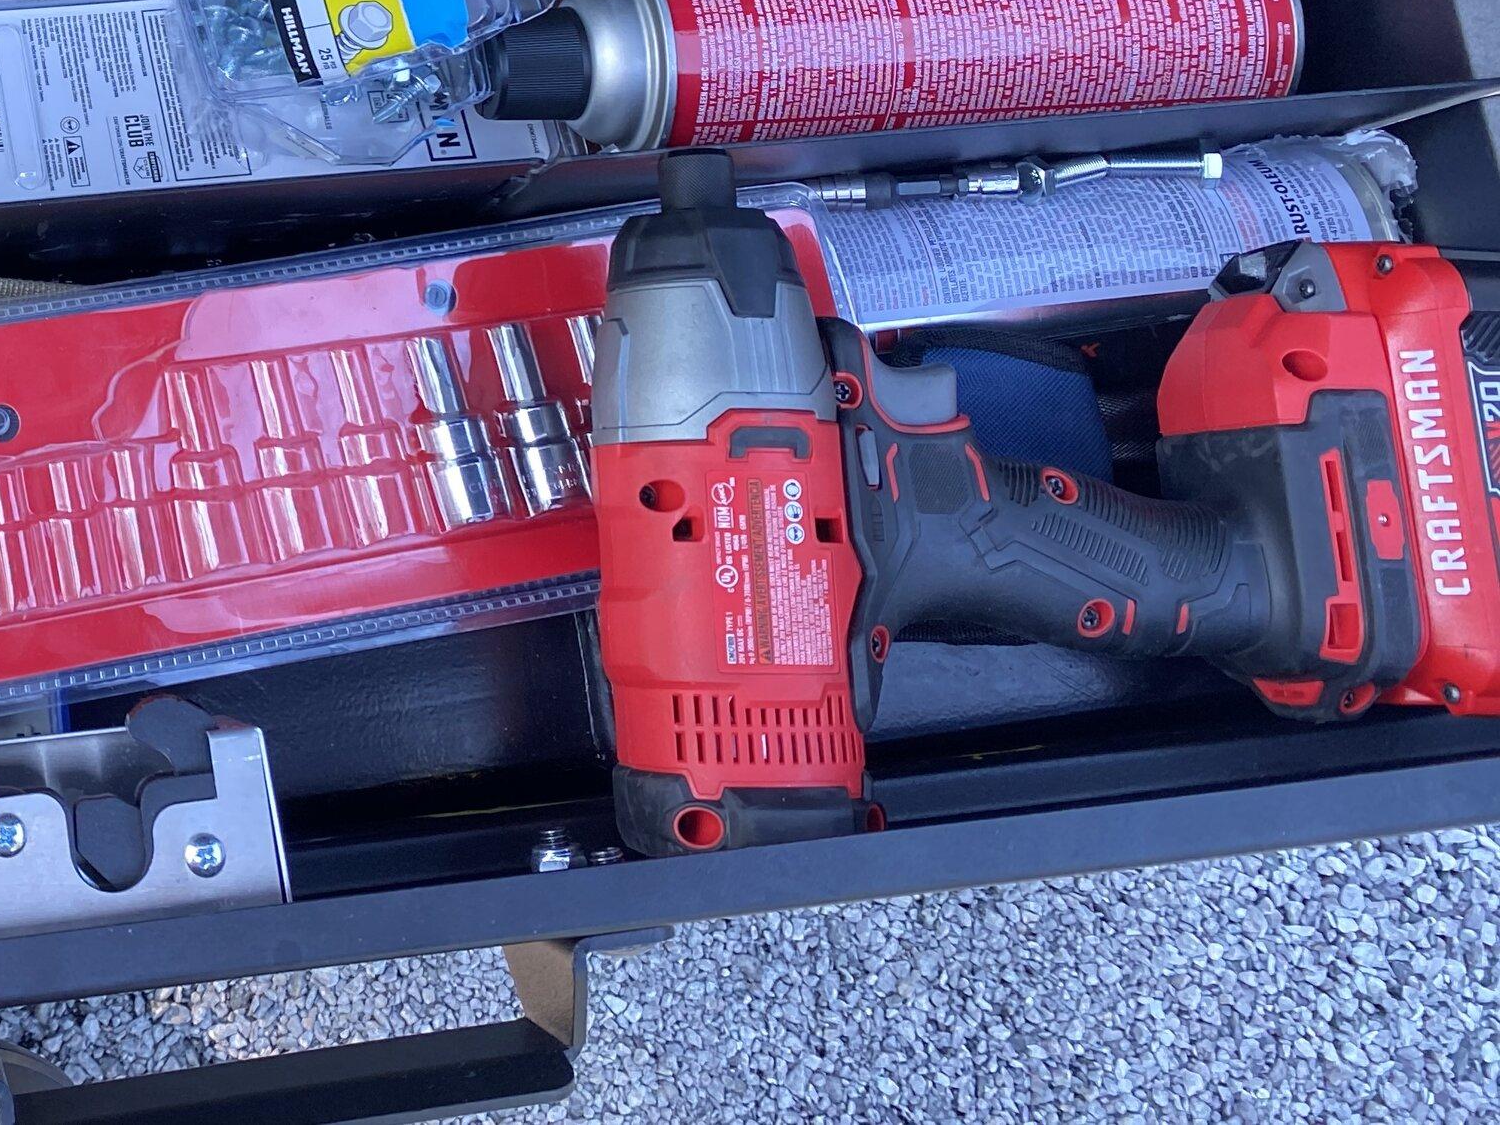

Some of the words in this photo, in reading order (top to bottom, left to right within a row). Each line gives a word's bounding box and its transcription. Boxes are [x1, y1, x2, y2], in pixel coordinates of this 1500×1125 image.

[279, 4, 311, 76] HILLMAN
[318, 46, 333, 62] 25
[123, 113, 144, 148] CLUB
[139, 113, 151, 131] JOIN
[143, 132, 154, 147] THE
[1248, 159, 1311, 235] RUST-OLEUM
[1399, 349, 1472, 596] CRAFTSMAN
[715, 505, 732, 528] NOM
[723, 531, 733, 554] LISTED
[737, 637, 745, 652] MAX
